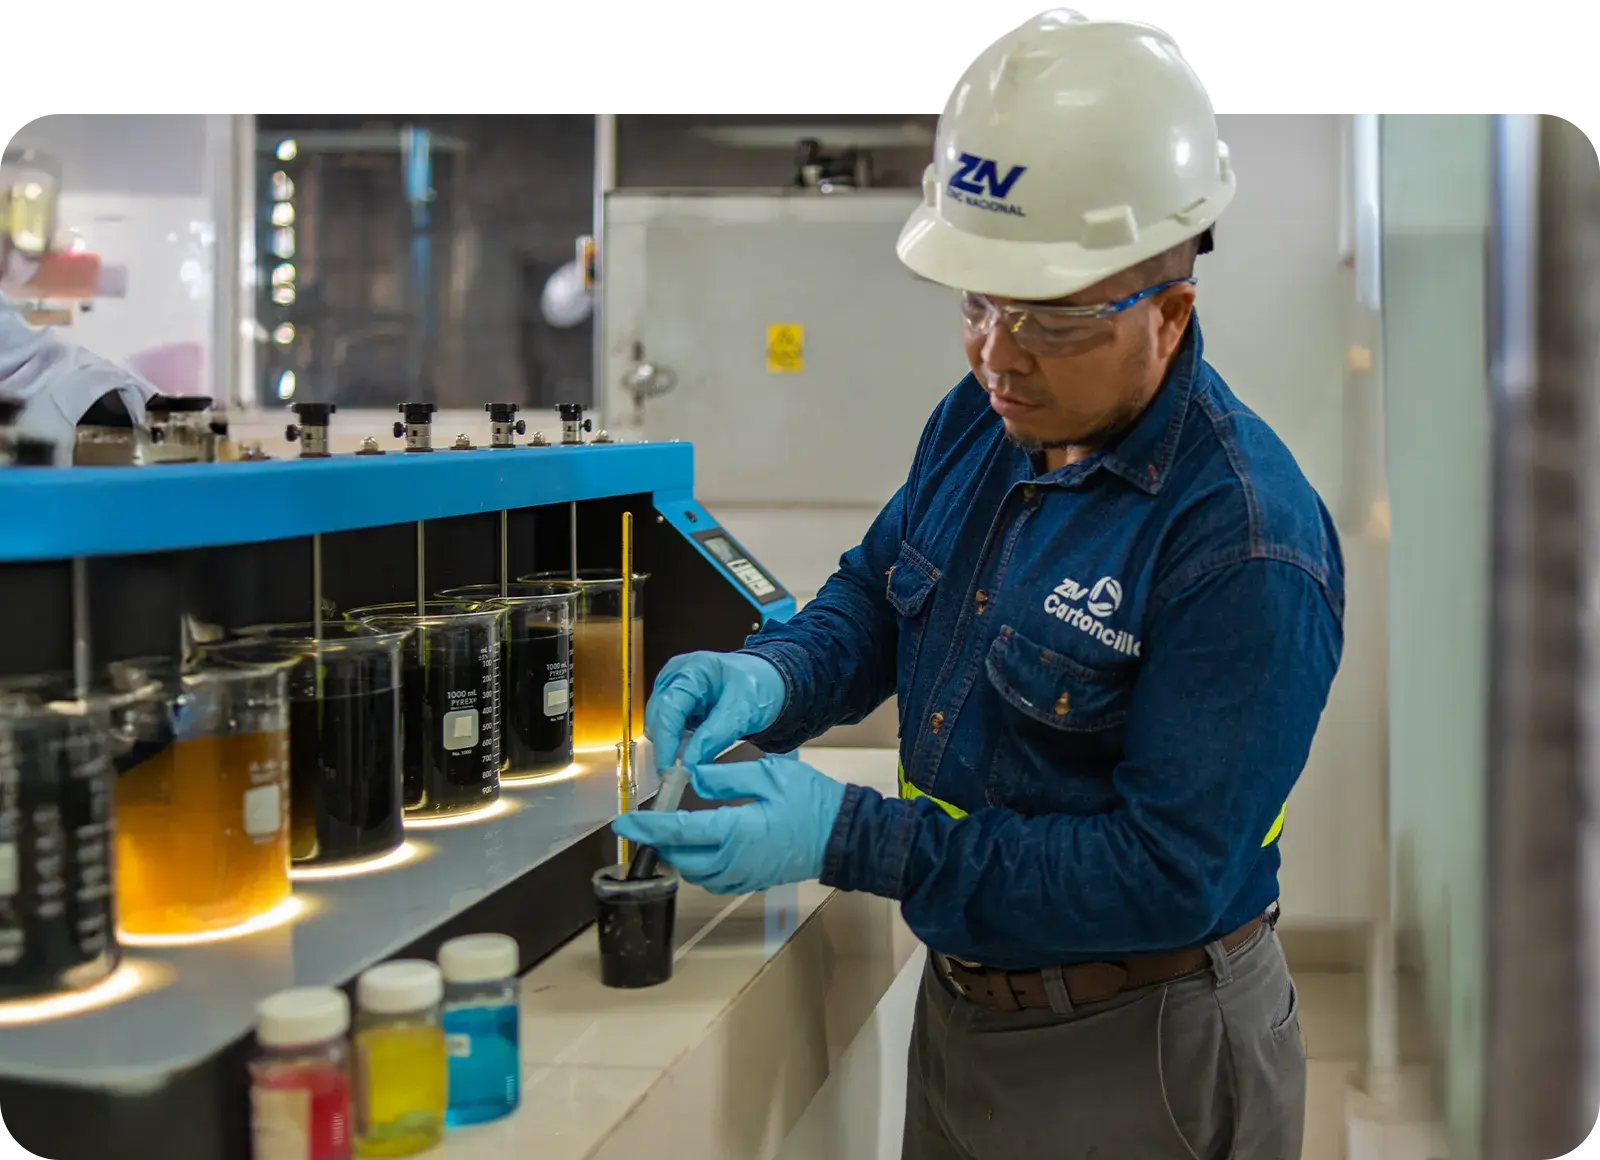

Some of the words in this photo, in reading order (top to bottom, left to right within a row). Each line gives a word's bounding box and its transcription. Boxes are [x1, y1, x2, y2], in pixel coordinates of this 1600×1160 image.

[948, 152, 1027, 199] ZN
[965, 196, 1027, 217] NACIONAL
[1054, 578, 1089, 600] ZN
[546, 662, 560, 670] 1000
[482, 674, 492, 683] 200
[447, 690, 467, 699] 1000
[467, 689, 477, 697] mL
[482, 690, 492, 699] 300
[482, 706, 492, 715] 400
[482, 722, 492, 731] 500
[482, 738, 492, 747] 600
[482, 754, 492, 763] 700
[482, 770, 492, 779] 800
[482, 785, 492, 794] 900
